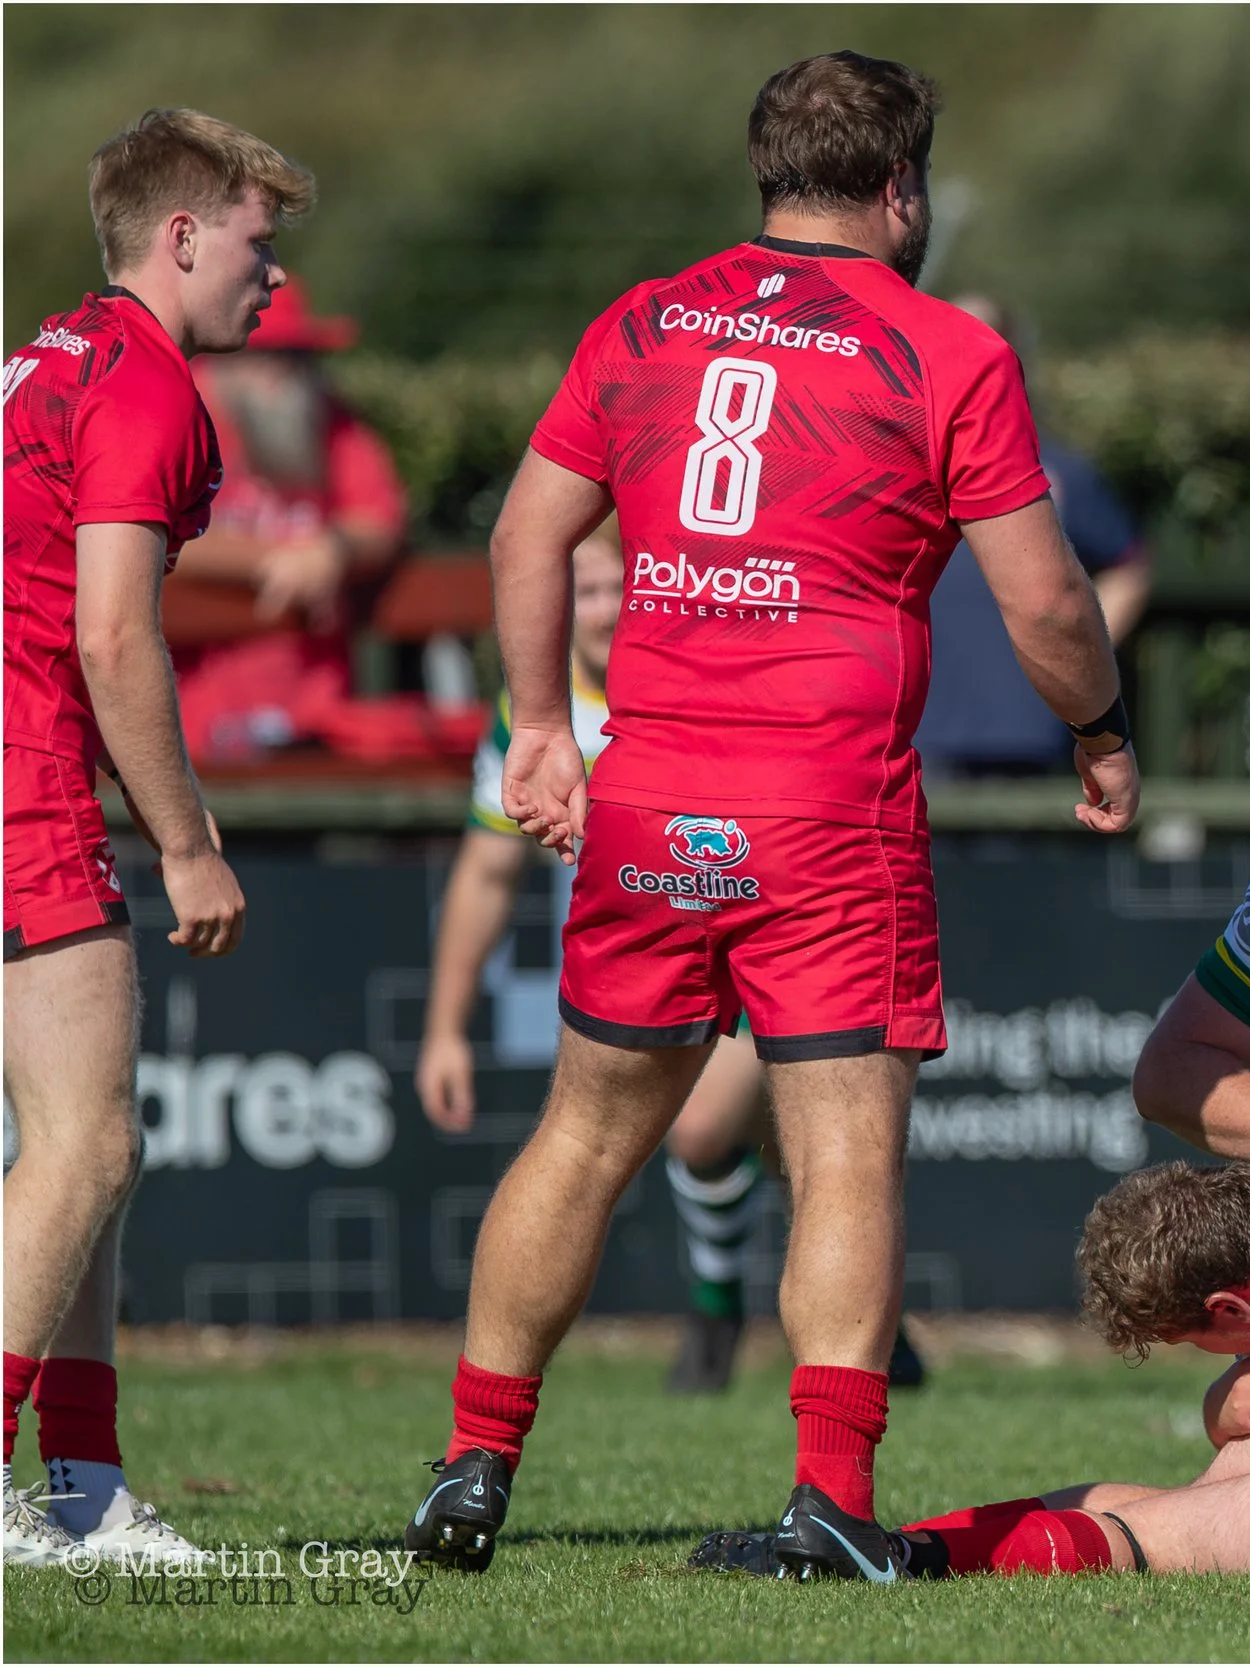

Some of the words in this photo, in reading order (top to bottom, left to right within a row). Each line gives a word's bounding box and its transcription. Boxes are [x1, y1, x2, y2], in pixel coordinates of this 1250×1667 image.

[659, 303, 861, 357] CoinShares
[679, 356, 778, 537] 8
[633, 552, 800, 603] Polygon
[628, 600, 798, 623] COLLECTIVE
[618, 864, 760, 900] Coastline
